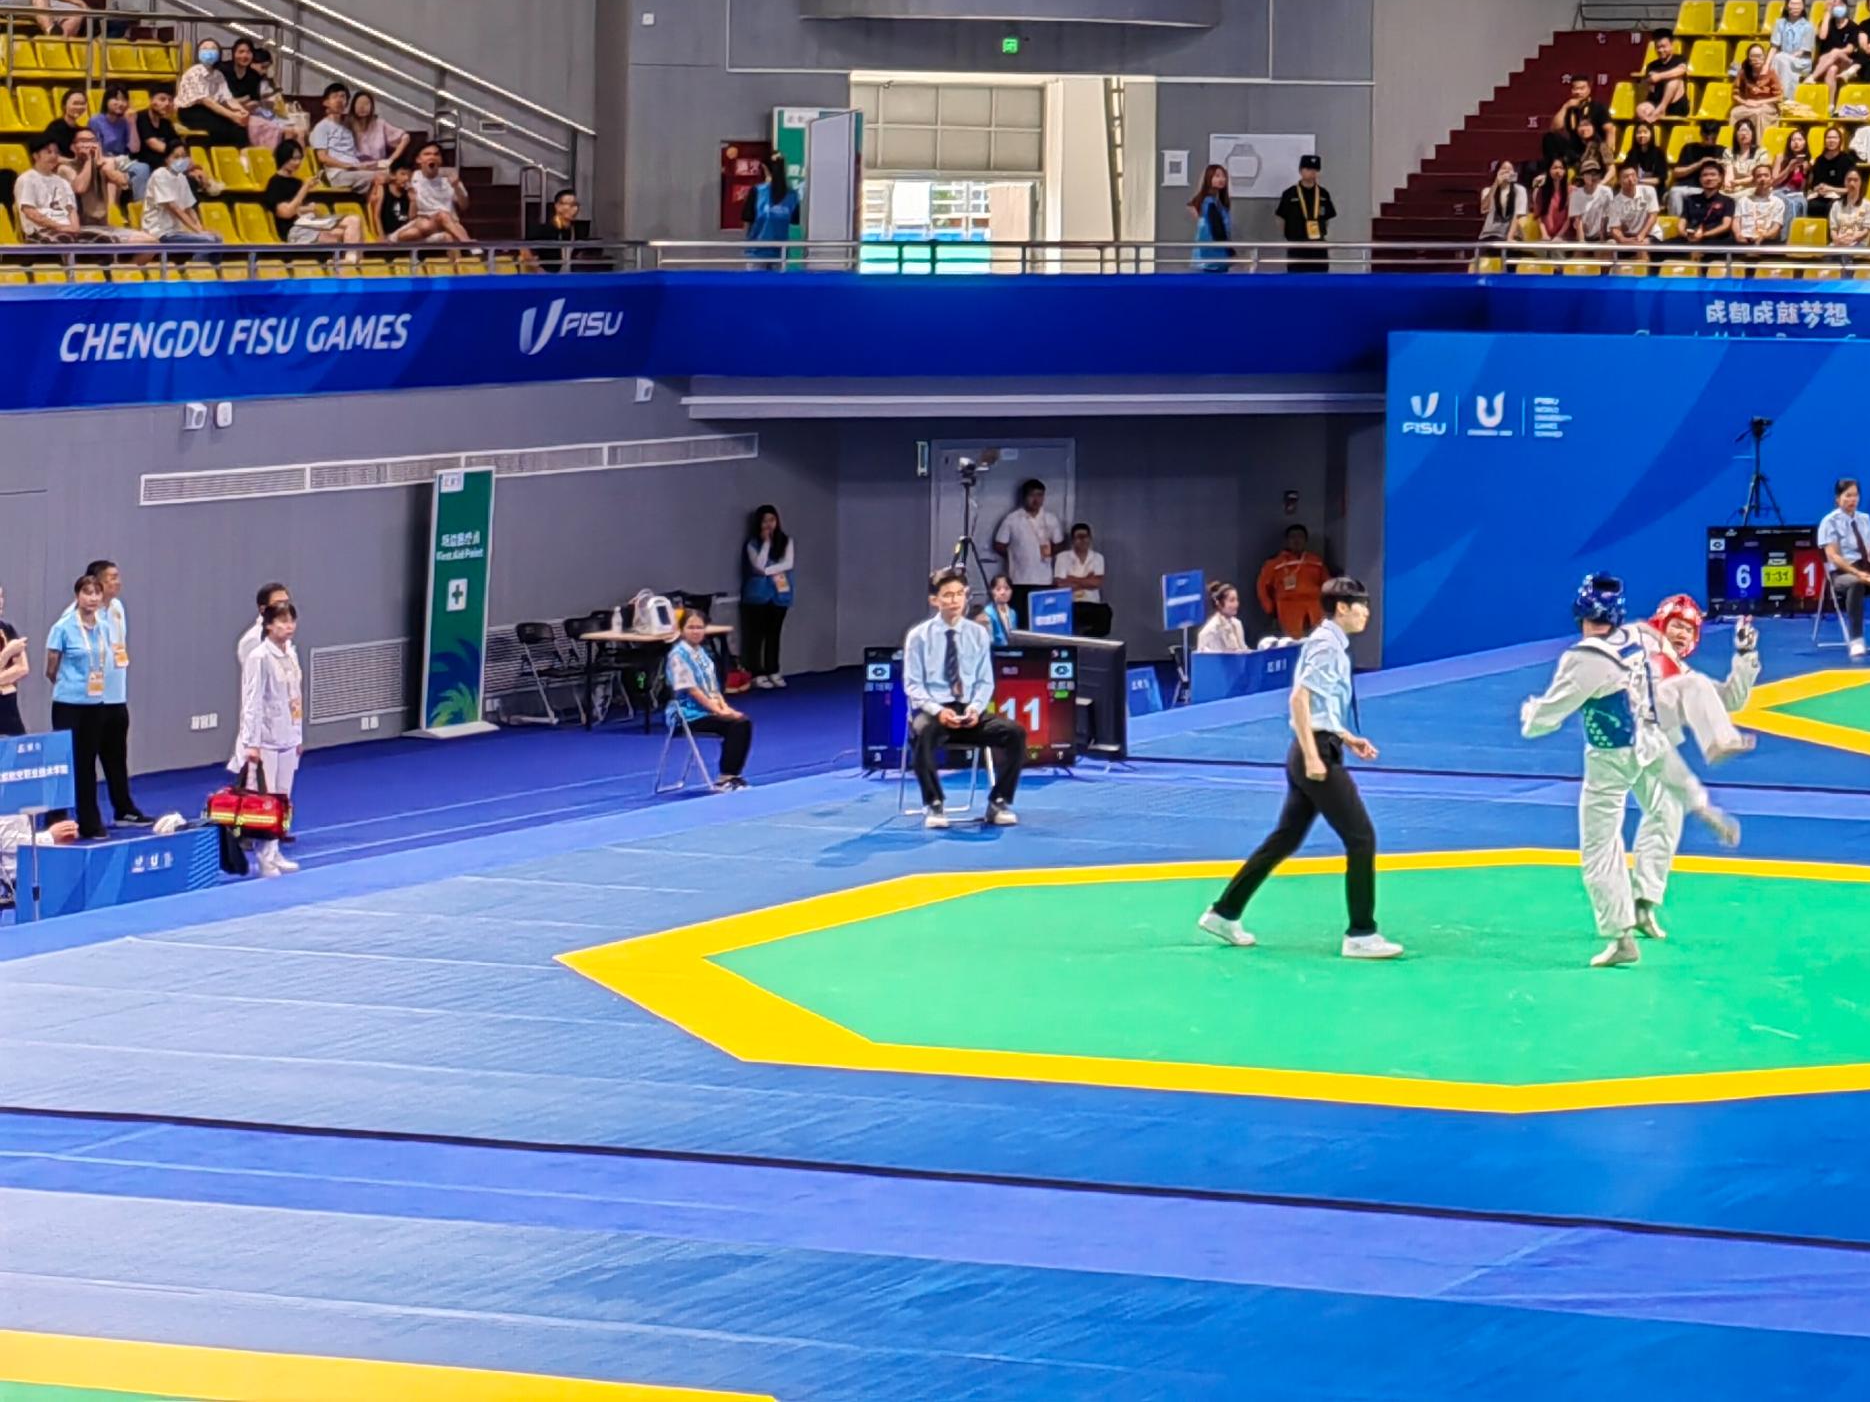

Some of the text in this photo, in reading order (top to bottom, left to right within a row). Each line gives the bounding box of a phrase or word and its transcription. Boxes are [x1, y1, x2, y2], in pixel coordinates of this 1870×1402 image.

[59, 313, 413, 362] CHENGDU FISU GAMES
[558, 310, 623, 339] FISU
[1402, 421, 1447, 436] FISU
[1736, 564, 1751, 590] 6
[1803, 562, 1816, 589] 1
[998, 696, 1040, 731] 11
